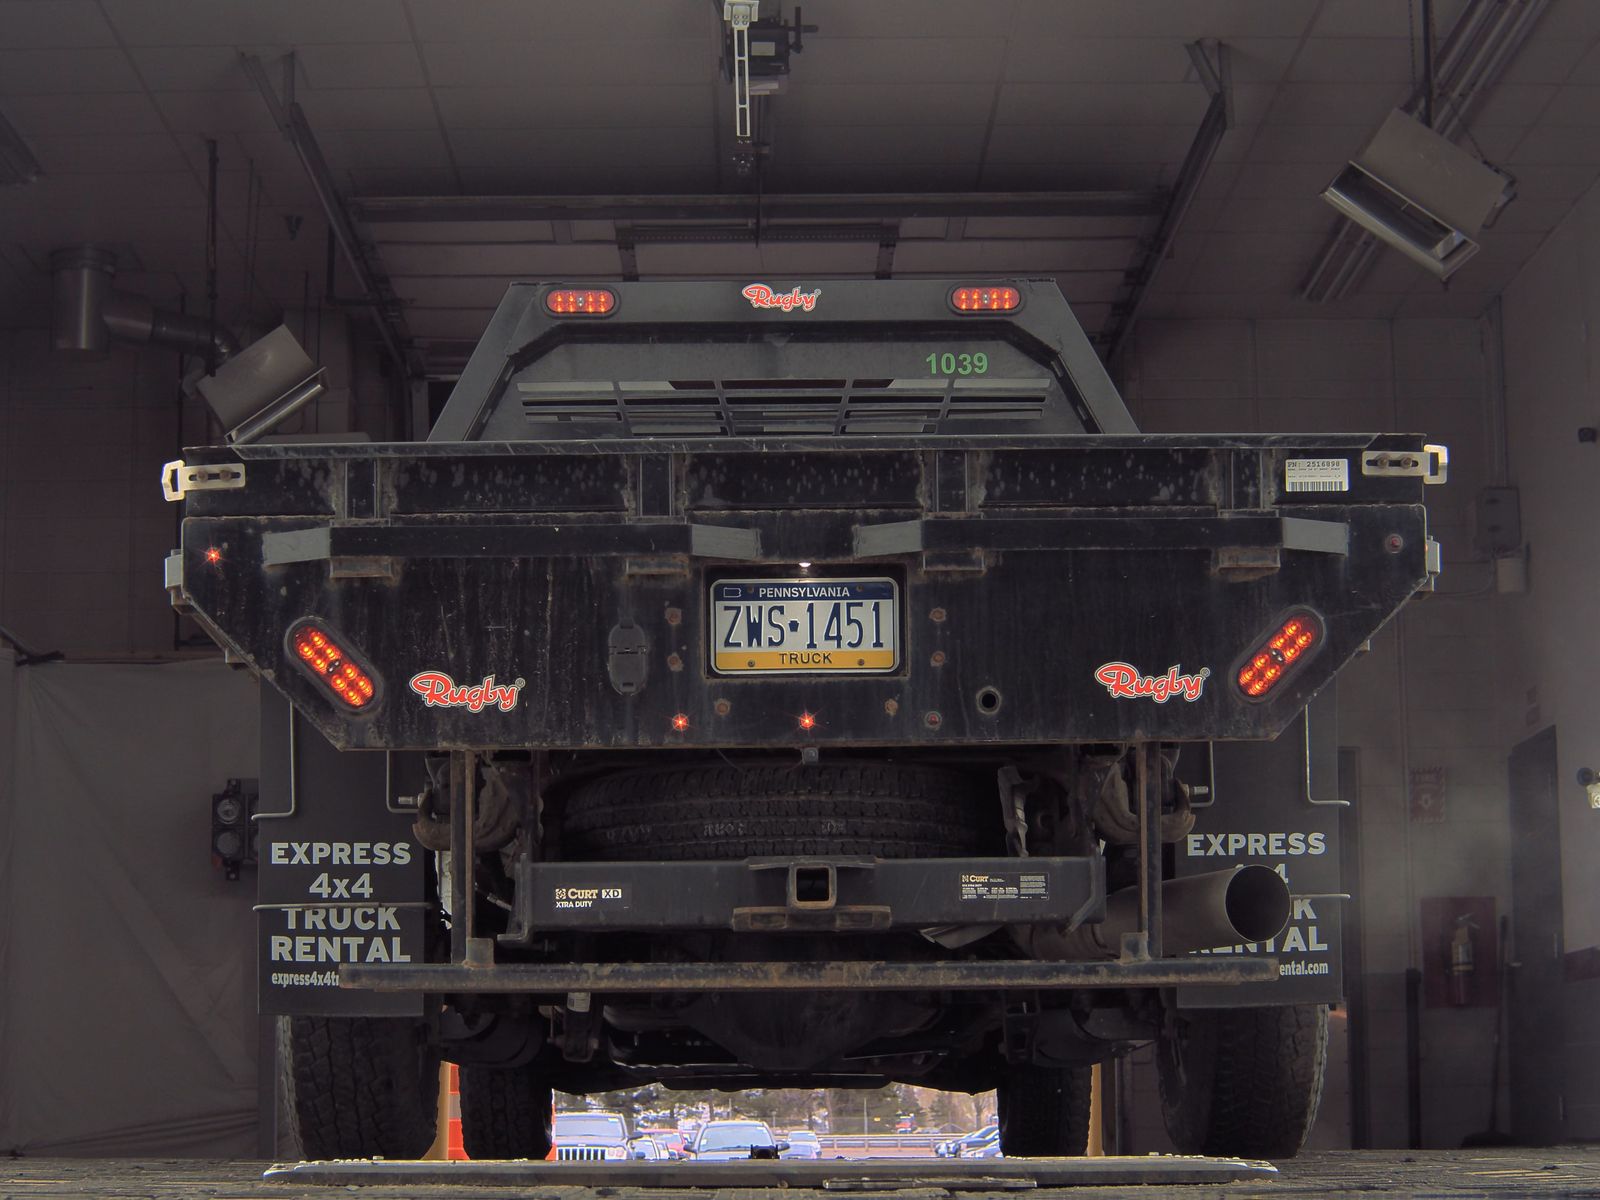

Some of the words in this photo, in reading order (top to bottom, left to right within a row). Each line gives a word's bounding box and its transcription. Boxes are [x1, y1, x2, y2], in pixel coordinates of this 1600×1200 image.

[742, 283, 817, 312] Rugby
[926, 352, 988, 375] 1039
[759, 587, 850, 598] PENNSYLVANIA
[779, 653, 832, 664] TRUCK
[409, 670, 519, 713] Rugby
[1094, 661, 1204, 704] Rugby
[271, 842, 411, 865] EXPRESS
[1187, 832, 1326, 856] EXPRESS
[309, 872, 374, 899] 4x4
[603, 889, 621, 898] XD
[575, 900, 592, 908] DUTY
[281, 906, 401, 931] TRUCK
[271, 936, 411, 963] RENTAL
